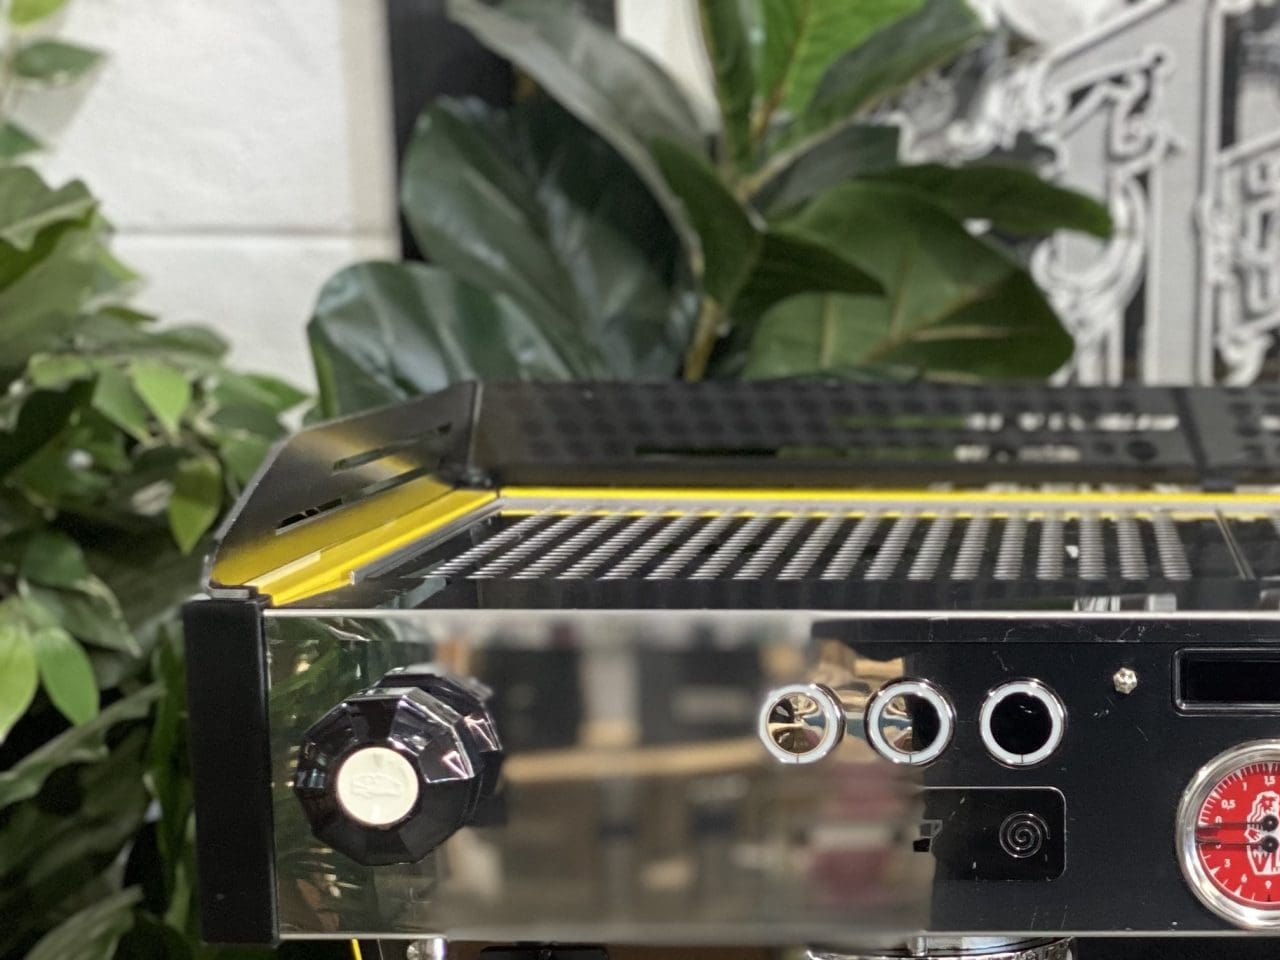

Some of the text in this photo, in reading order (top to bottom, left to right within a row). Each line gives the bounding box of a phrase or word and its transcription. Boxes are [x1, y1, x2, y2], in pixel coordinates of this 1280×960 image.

[1224, 858, 1231, 868] 3
[1240, 873, 1248, 884] 6
[1264, 880, 1272, 890] 9
